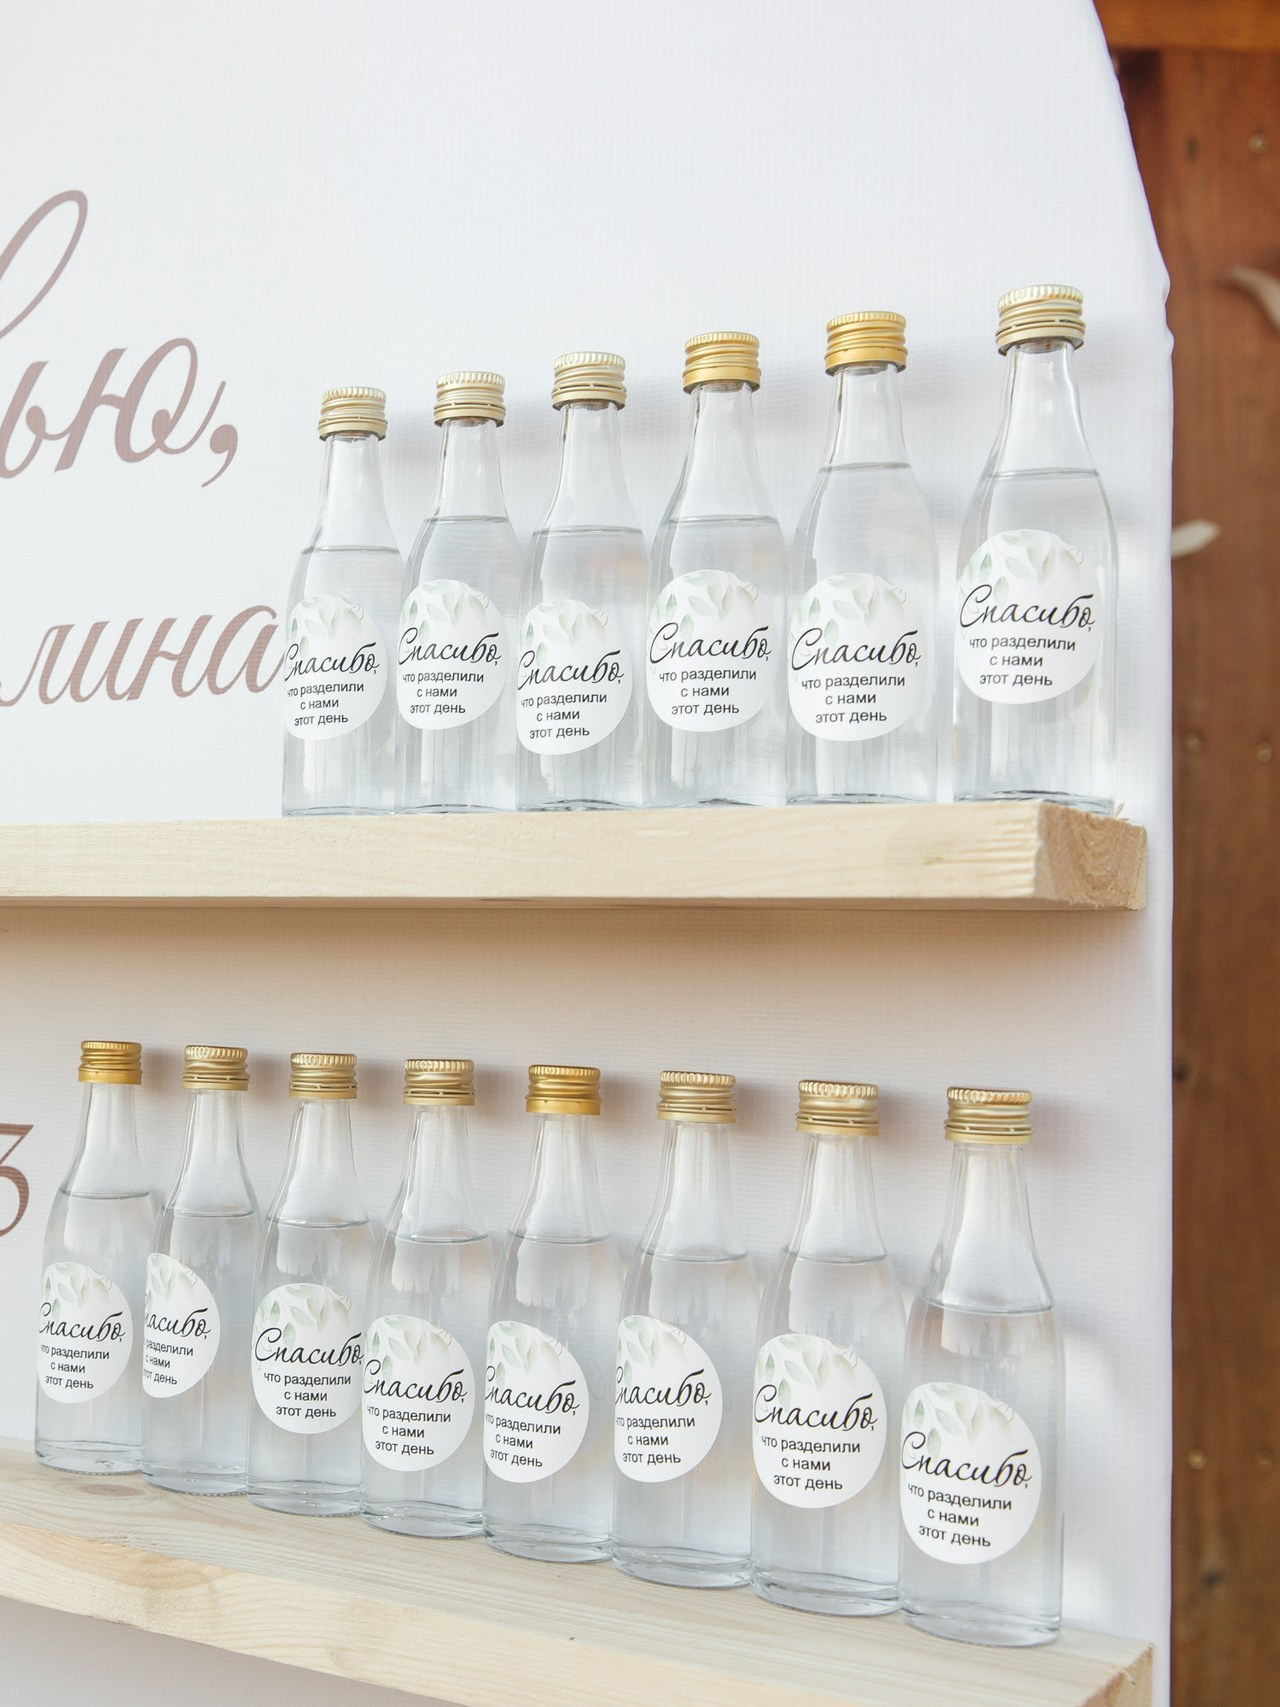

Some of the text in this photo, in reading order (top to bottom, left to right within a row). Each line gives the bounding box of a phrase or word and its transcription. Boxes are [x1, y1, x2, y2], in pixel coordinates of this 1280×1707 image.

[960, 584, 1095, 632] Спасибо,
[398, 627, 501, 666] Спасибо,
[650, 622, 772, 664] Спасибо,
[792, 627, 921, 671] Спасибо,
[970, 637, 1075, 650] что разделили
[285, 642, 380, 681] Спасибо,
[989, 655, 1043, 666] с нами
[517, 650, 624, 690] Спасибо,
[660, 670, 756, 683] что разделили
[403, 672, 484, 684] что разделили
[802, 676, 905, 690] что разделили
[980, 674, 1053, 686] этот день
[301, 683, 364, 697] разделили
[417, 688, 457, 697] с нами
[681, 687, 729, 697] с нами
[300, 699, 338, 710] с нами
[537, 694, 607, 708] разделили
[825, 694, 876, 705] с нами
[410, 704, 466, 715] этот день
[536, 711, 580, 721] с нами
[672, 704, 739, 715] этот день
[294, 715, 348, 726] этот день
[816, 712, 887, 724] этот день
[530, 728, 590, 739] этот день
[255, 1327, 364, 1366] Спасибо,
[51, 1347, 109, 1360] разделили
[51, 1361, 85, 1373] с нами
[150, 1357, 170, 1368] нами
[65, 1379, 94, 1389] день
[154, 1373, 177, 1385] день
[264, 1373, 351, 1387] что разделили
[364, 1359, 467, 1403] Спасибо,
[284, 1391, 327, 1401] с нами
[276, 1406, 336, 1418] этот день
[754, 1384, 878, 1432] Спасибо,
[383, 1409, 451, 1422] разделили
[496, 1416, 561, 1434] разделили
[627, 1417, 695, 1430] разделили
[382, 1425, 425, 1438] с нами
[496, 1433, 533, 1449] с нами
[628, 1434, 668, 1445] с нами
[762, 1435, 860, 1453] что разделили
[375, 1440, 434, 1456] этот день
[490, 1449, 543, 1468] этот день
[623, 1452, 681, 1465] этот день
[781, 1457, 830, 1471] с нами
[902, 1431, 1032, 1489] Спасибо,
[774, 1474, 843, 1491] этот день
[908, 1483, 1012, 1510] что разделили
[927, 1508, 979, 1526] с нами
[919, 1525, 991, 1547] этот день
